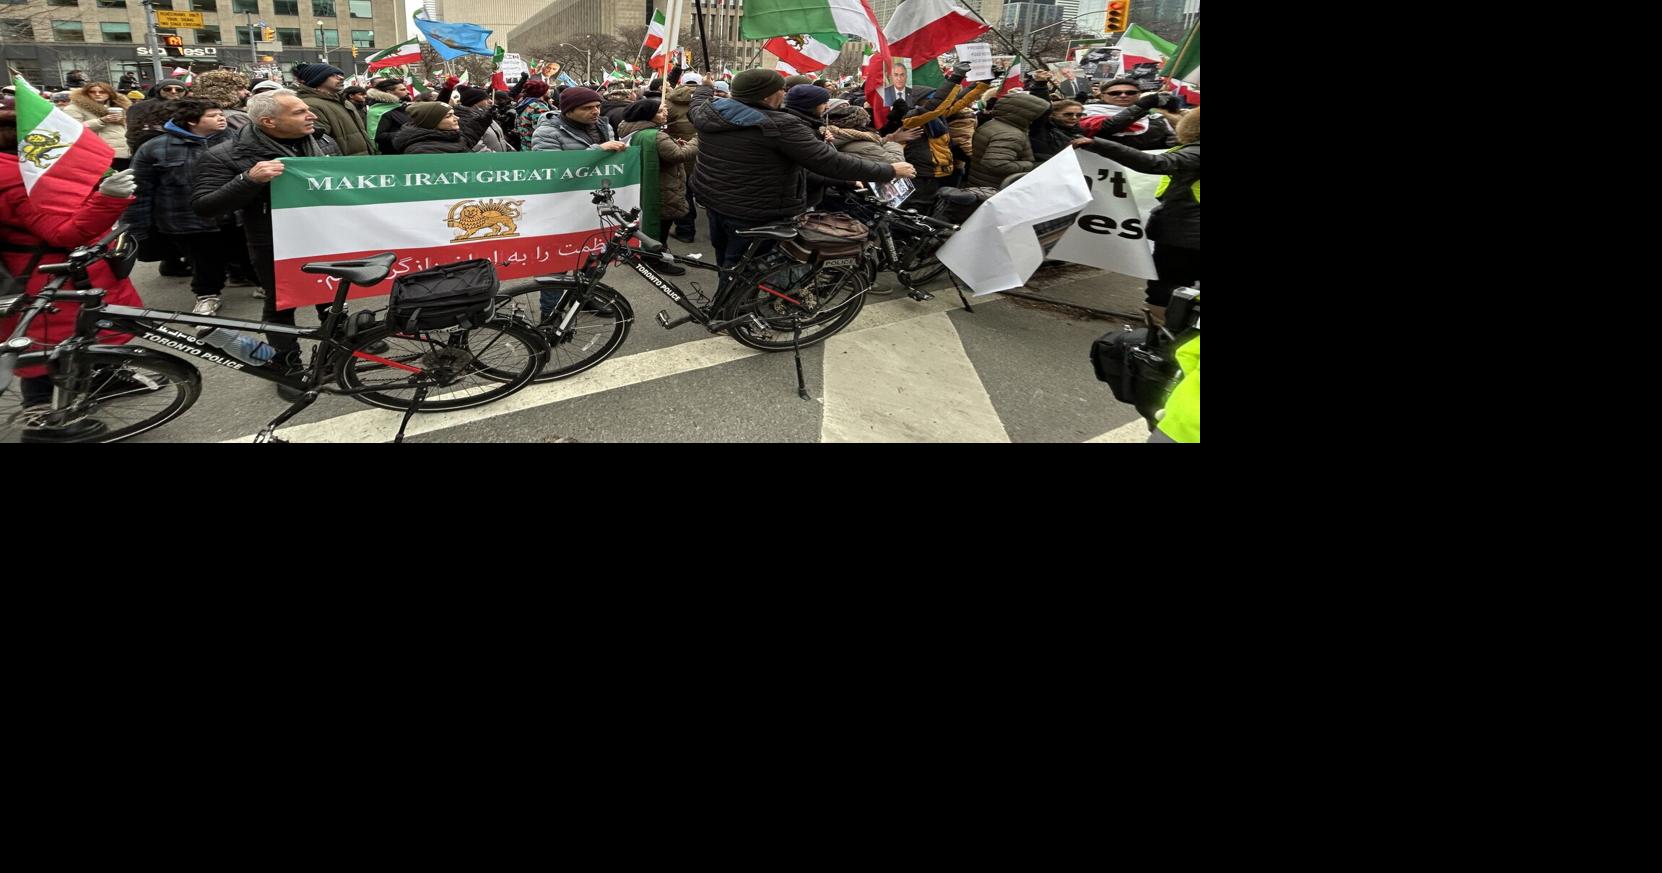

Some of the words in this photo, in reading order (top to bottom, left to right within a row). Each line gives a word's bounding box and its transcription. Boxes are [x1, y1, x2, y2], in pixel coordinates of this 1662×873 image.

[306, 174, 396, 191] MAKE
[404, 171, 468, 187] IRAN
[476, 168, 555, 183] GREAT
[560, 163, 625, 180] AGAIN
[508, 250, 527, 266] به
[536, 246, 550, 262] را
[635, 263, 662, 286] TORONTO
[660, 284, 681, 302] POLICE
[142, 332, 202, 355] TORONTO
[201, 352, 245, 370] POLICE
